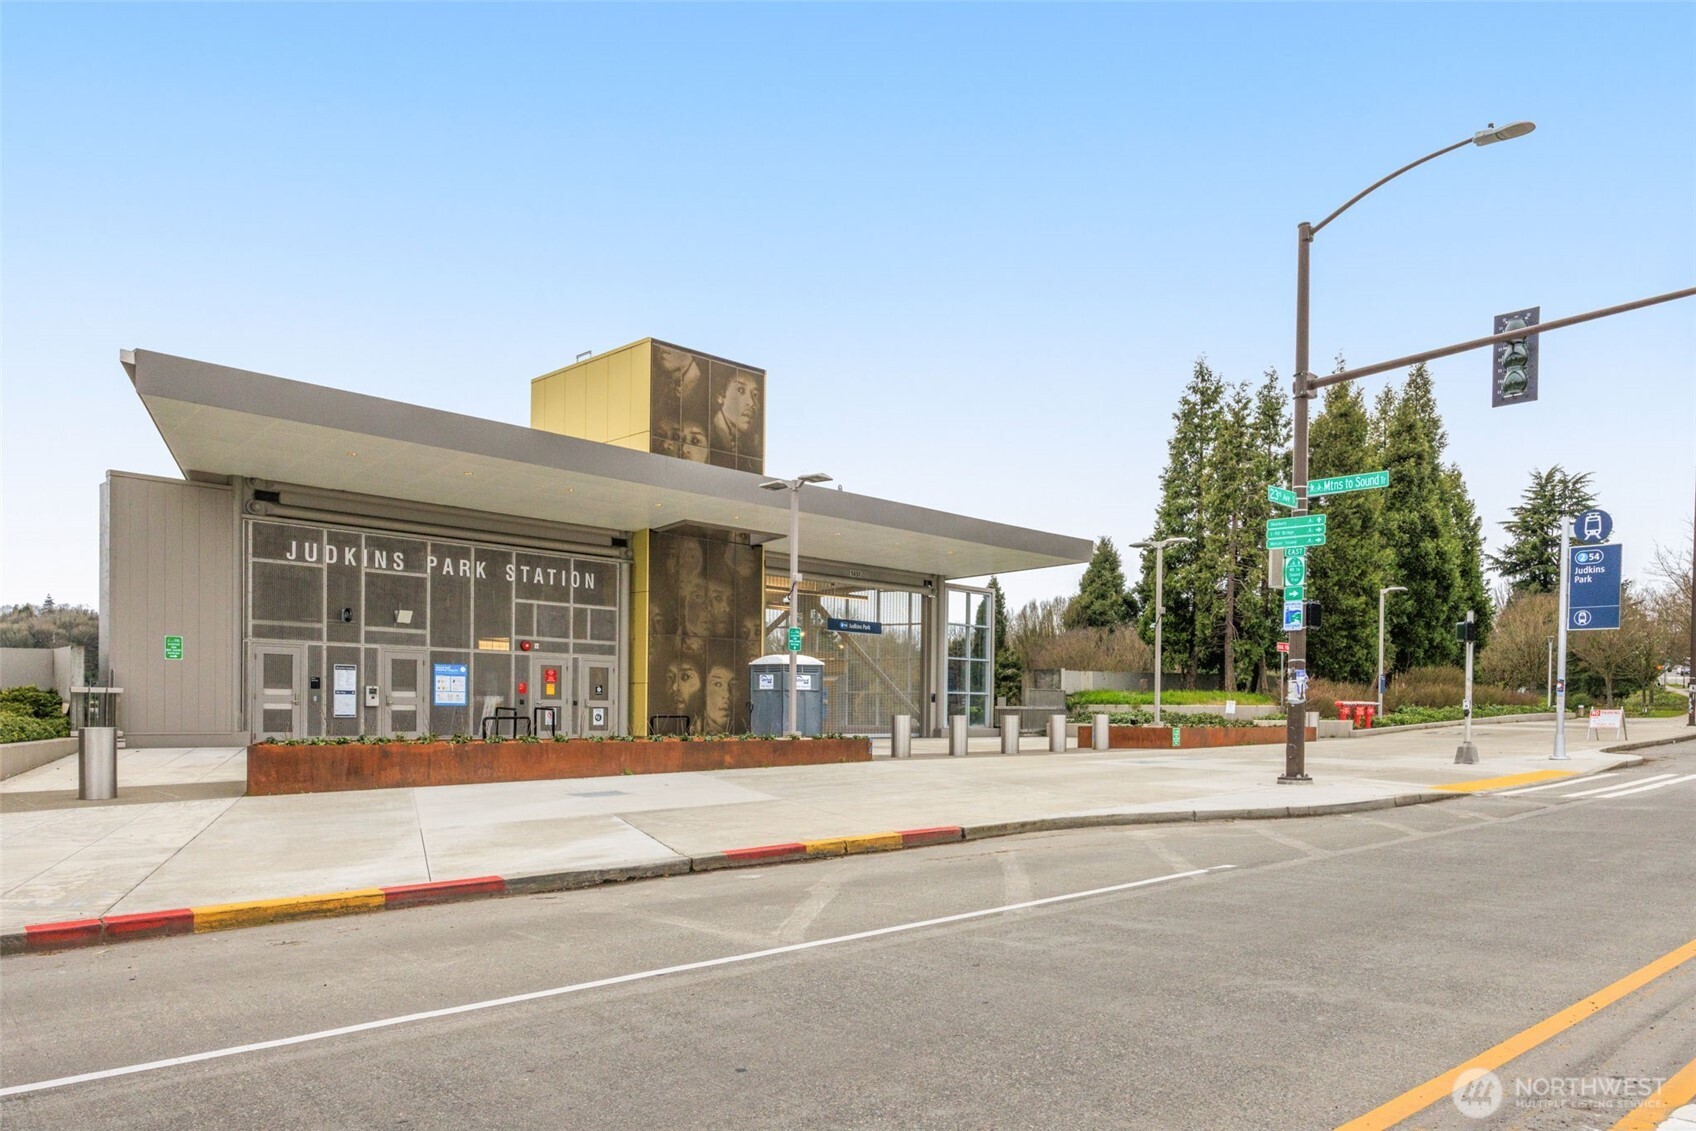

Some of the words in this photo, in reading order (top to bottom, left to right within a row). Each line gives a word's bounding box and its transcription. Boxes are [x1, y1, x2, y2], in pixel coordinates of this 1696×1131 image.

[1323, 480, 1343, 492] Mtns
[1345, 478, 1353, 489] to
[1355, 474, 1379, 488] Sound
[1380, 475, 1387, 485] Tr
[1287, 548, 1303, 556] EAST
[1588, 552, 1600, 561] 54
[286, 541, 404, 571] JUDKINS
[427, 556, 487, 579] PARK
[505, 564, 595, 589] STATION
[1574, 565, 1606, 575] Judkins
[1574, 575, 1593, 583] Park
